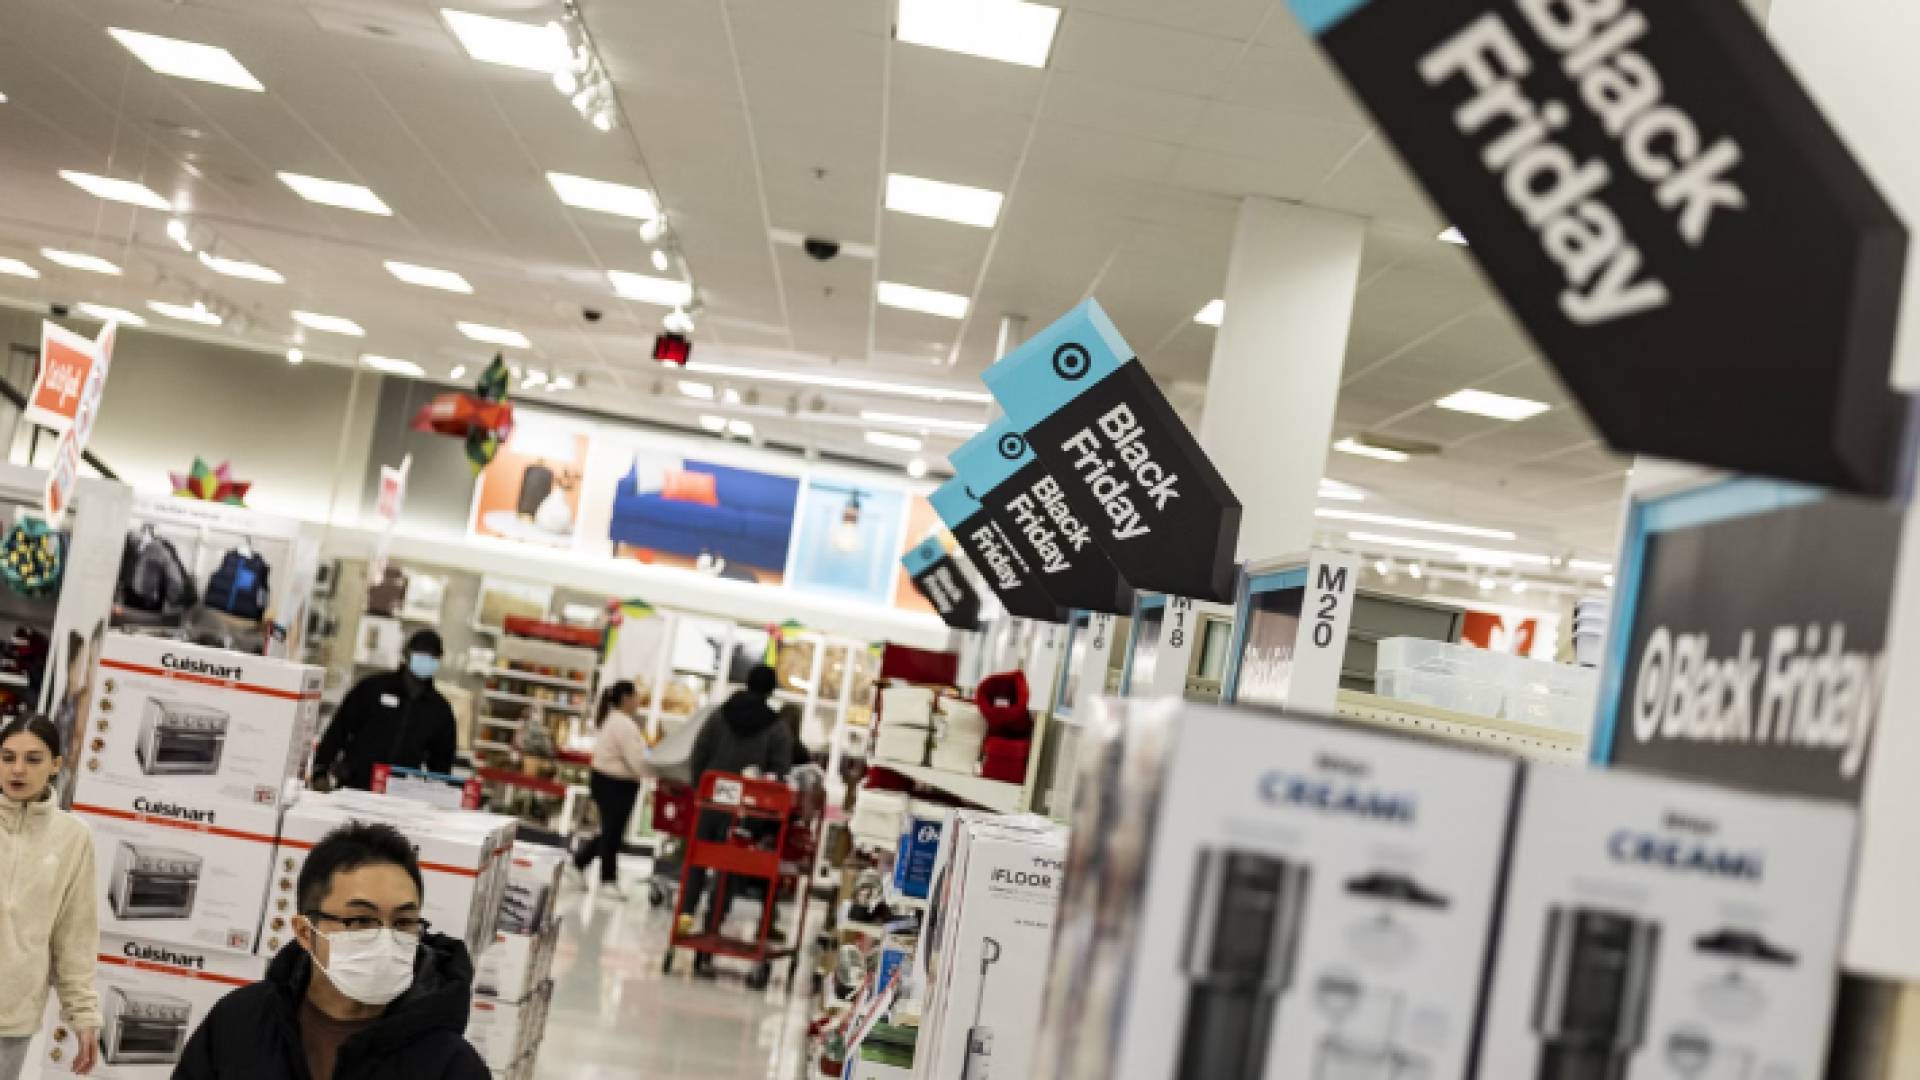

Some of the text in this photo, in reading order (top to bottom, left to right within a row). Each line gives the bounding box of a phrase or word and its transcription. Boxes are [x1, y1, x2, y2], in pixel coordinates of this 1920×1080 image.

[1417, 12, 1670, 325] Friday
[1061, 426, 1151, 540] Friday
[1097, 401, 1181, 512] Black
[1006, 493, 1072, 573] Friday
[1031, 474, 1092, 553] Black
[970, 525, 1022, 589] Friday
[1313, 563, 1348, 648] M20
[161, 652, 243, 681] Cuisinart
[1660, 619, 1888, 780] Black Friday
[132, 795, 216, 824] Cuisinart
[123, 940, 206, 970] Cuisinart
